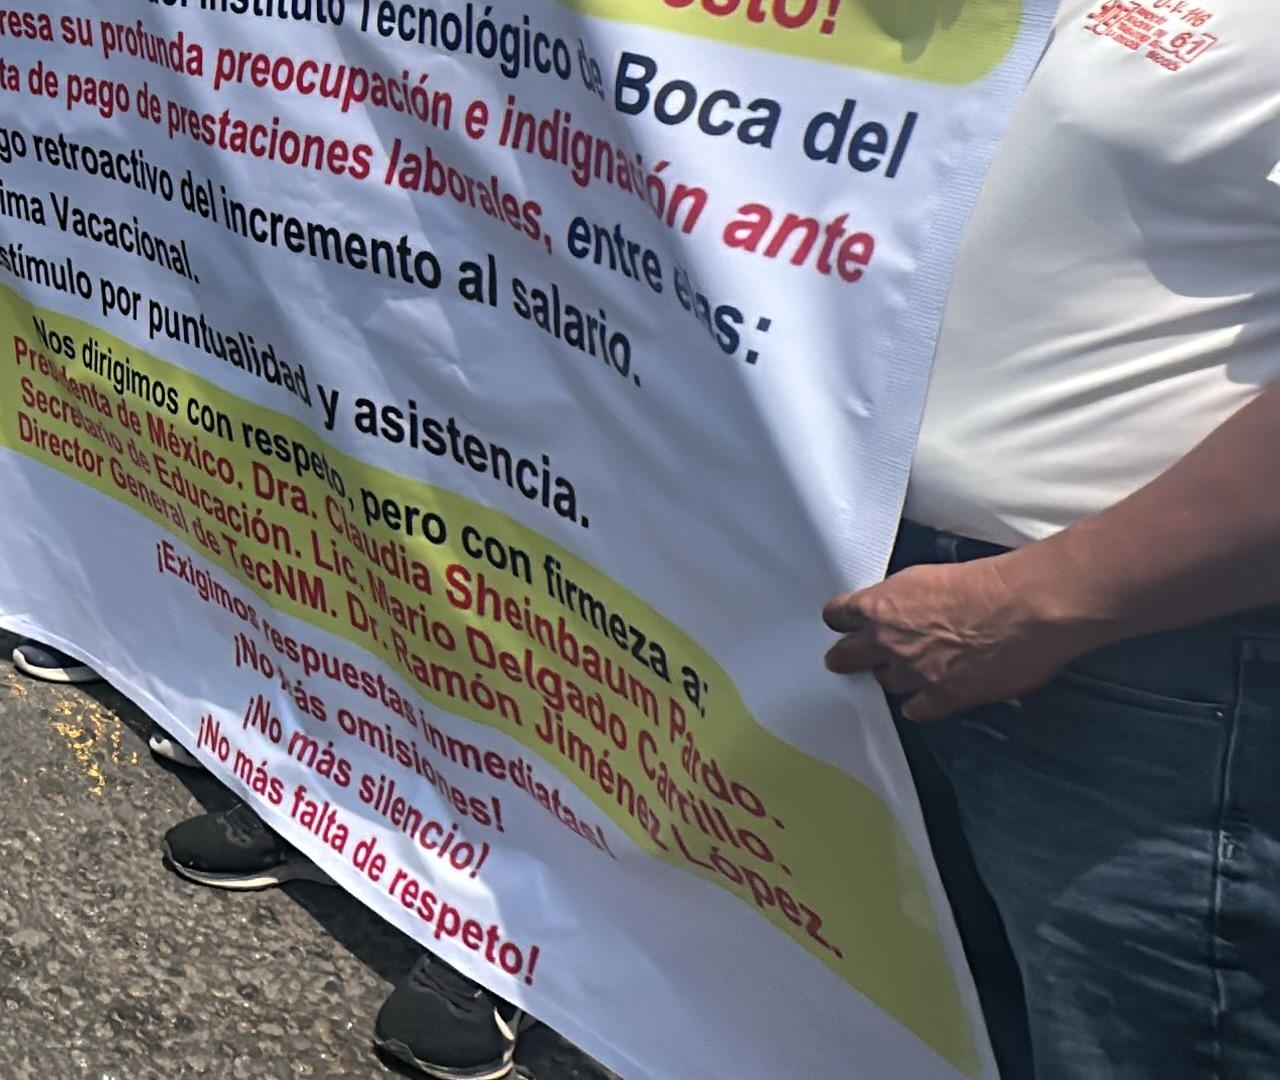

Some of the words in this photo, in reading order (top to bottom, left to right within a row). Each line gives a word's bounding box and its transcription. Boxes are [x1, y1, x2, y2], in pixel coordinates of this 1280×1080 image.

[28, 61, 59, 99] de
[67, 74, 130, 119] pago
[137, 81, 161, 126] de
[168, 99, 374, 180] prestaciones
[385, 137, 553, 255] laborales,
[567, 215, 663, 294] entre
[50, 192, 200, 284] Vacacional.
[61, 16, 93, 47] su
[102, 19, 204, 77] profunda
[215, 47, 452, 131] preocupación
[466, 100, 489, 139] e
[723, 202, 874, 283] ante
[615, 51, 782, 149] Boca
[804, 99, 918, 178] del
[33, 133, 174, 202] retroactivo
[180, 169, 216, 222] del
[222, 187, 441, 290] incremento
[458, 254, 498, 307] al
[512, 277, 642, 390] salario.
[32, 314, 76, 360] Nos
[82, 337, 180, 415] dirigimos
[187, 397, 234, 442] con
[242, 420, 355, 512] respeto,
[360, 486, 447, 546] pero
[461, 524, 533, 585] con
[543, 555, 673, 684] firmeza
[100, 277, 141, 321] por
[148, 301, 312, 408] puntualidad
[316, 384, 340, 430] y
[354, 397, 590, 528] asistencia.
[18, 411, 104, 477] Director
[108, 456, 188, 533] General
[195, 518, 221, 556] de
[221, 533, 339, 618] TecNM.
[346, 591, 389, 651] Dr.
[391, 627, 521, 727] Ramón
[534, 707, 670, 853] Jiménez
[671, 822, 845, 960] López.
[117, 399, 142, 436] de
[146, 411, 243, 491] México.
[252, 461, 318, 520] Dra.
[325, 496, 433, 596] Claudia
[445, 565, 660, 723] Sheinbaum
[668, 697, 786, 830] Pardo.
[127, 438, 151, 475] de
[153, 455, 302, 558] Educación.
[311, 530, 366, 593] Lic.
[369, 566, 456, 652] Mario
[465, 627, 628, 752] Delgado
[638, 730, 793, 878] Carrillo.
[156, 540, 260, 630] ¡Exigimos
[262, 618, 418, 732] respuestas
[419, 709, 619, 860] inmediatas!
[234, 632, 275, 680] ¡No
[337, 707, 506, 833] omisiones!
[196, 715, 231, 763] ¡No
[234, 749, 284, 806] más
[290, 784, 350, 854] falta
[352, 835, 387, 884] de
[388, 871, 541, 987] respeto!
[242, 694, 282, 743] ¡No
[287, 731, 351, 788] más
[358, 772, 490, 880] silencio!
